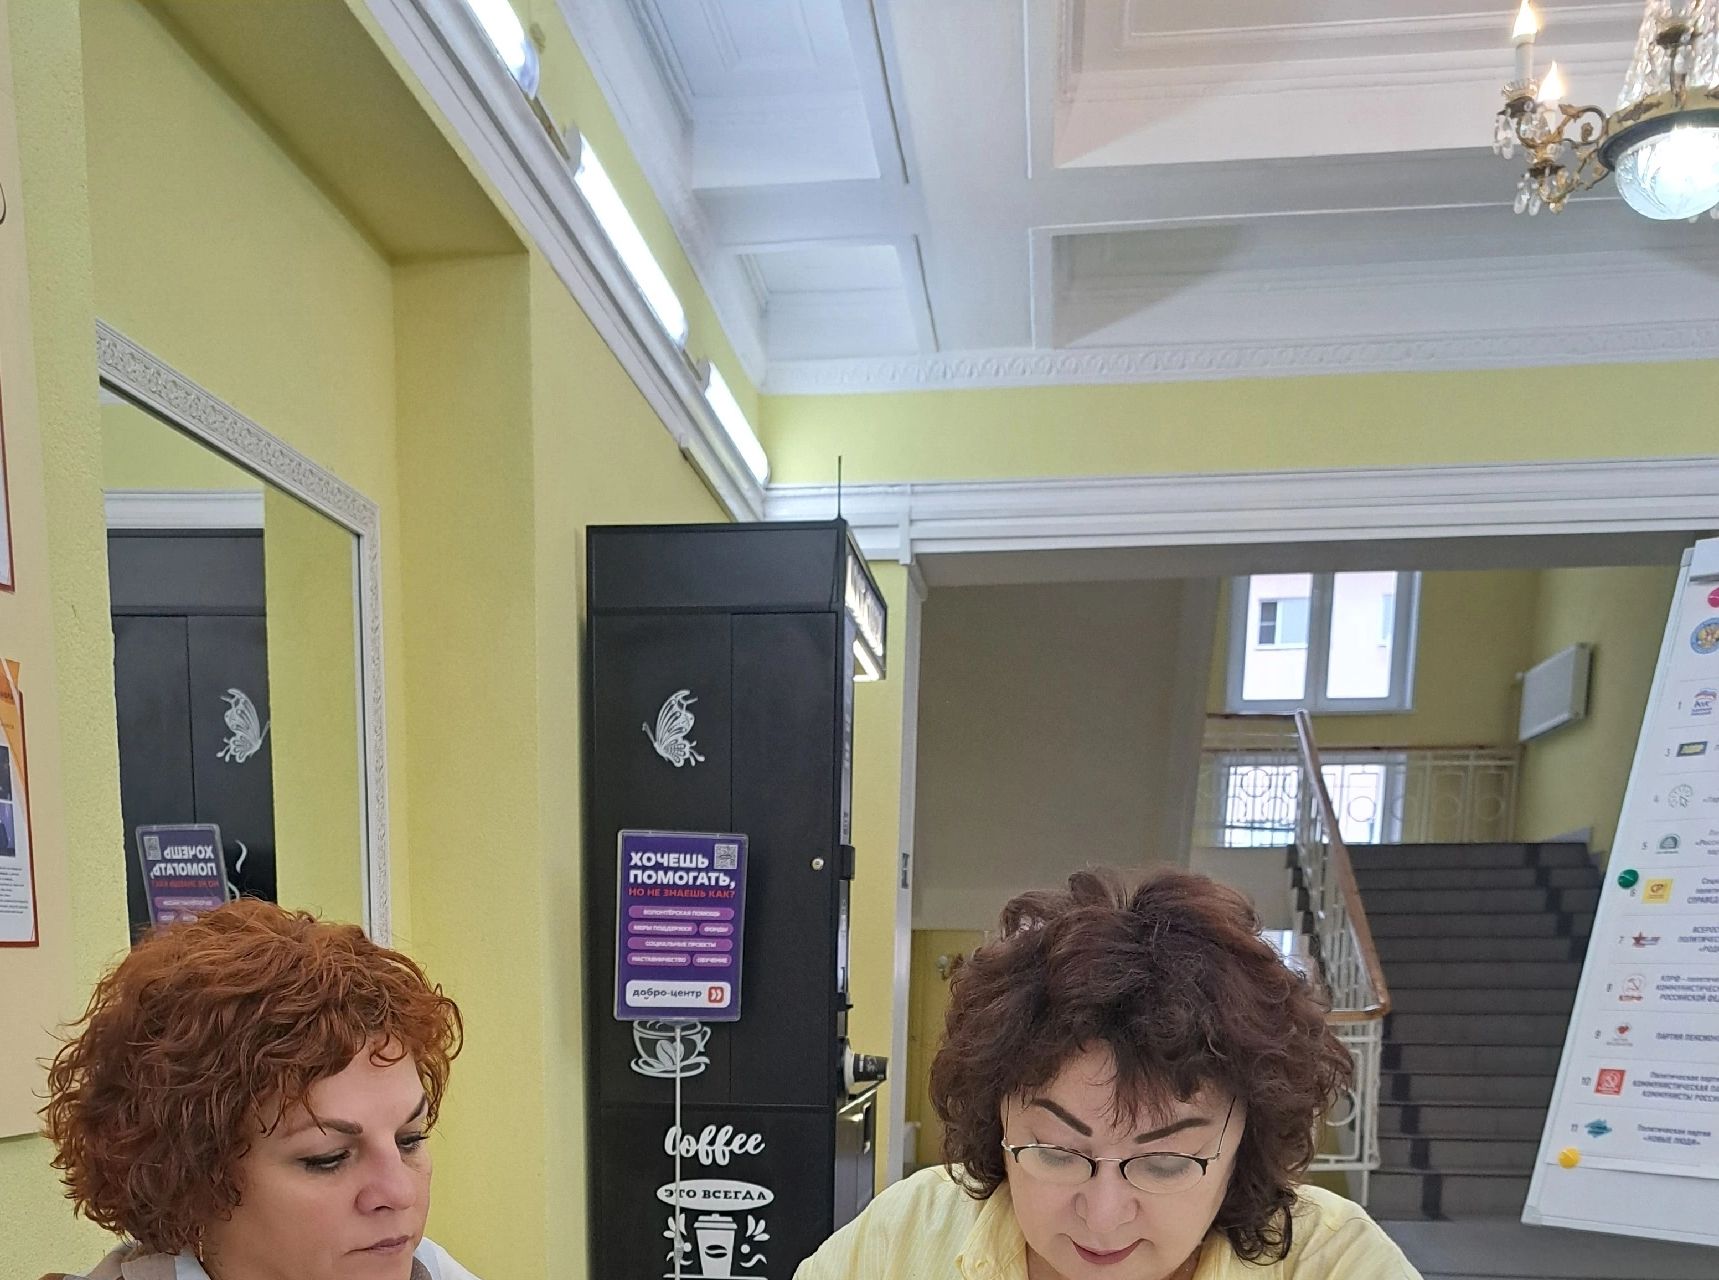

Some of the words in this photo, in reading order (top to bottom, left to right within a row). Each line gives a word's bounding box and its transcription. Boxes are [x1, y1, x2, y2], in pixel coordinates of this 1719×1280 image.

[629, 851, 709, 868] ХОЧЕШЬ
[629, 869, 736, 889] ПОМОГАТЬ,
[629, 888, 644, 897] НО
[647, 888, 660, 897] НЕ
[663, 889, 706, 898] ЗНАЕШЬ
[709, 890, 735, 899] КАК?
[632, 988, 702, 998] добро-центр
[664, 1125, 765, 1165] Coffee
[664, 1188, 697, 1199] ЭТО
[702, 1189, 767, 1201] ВСЕГДА
